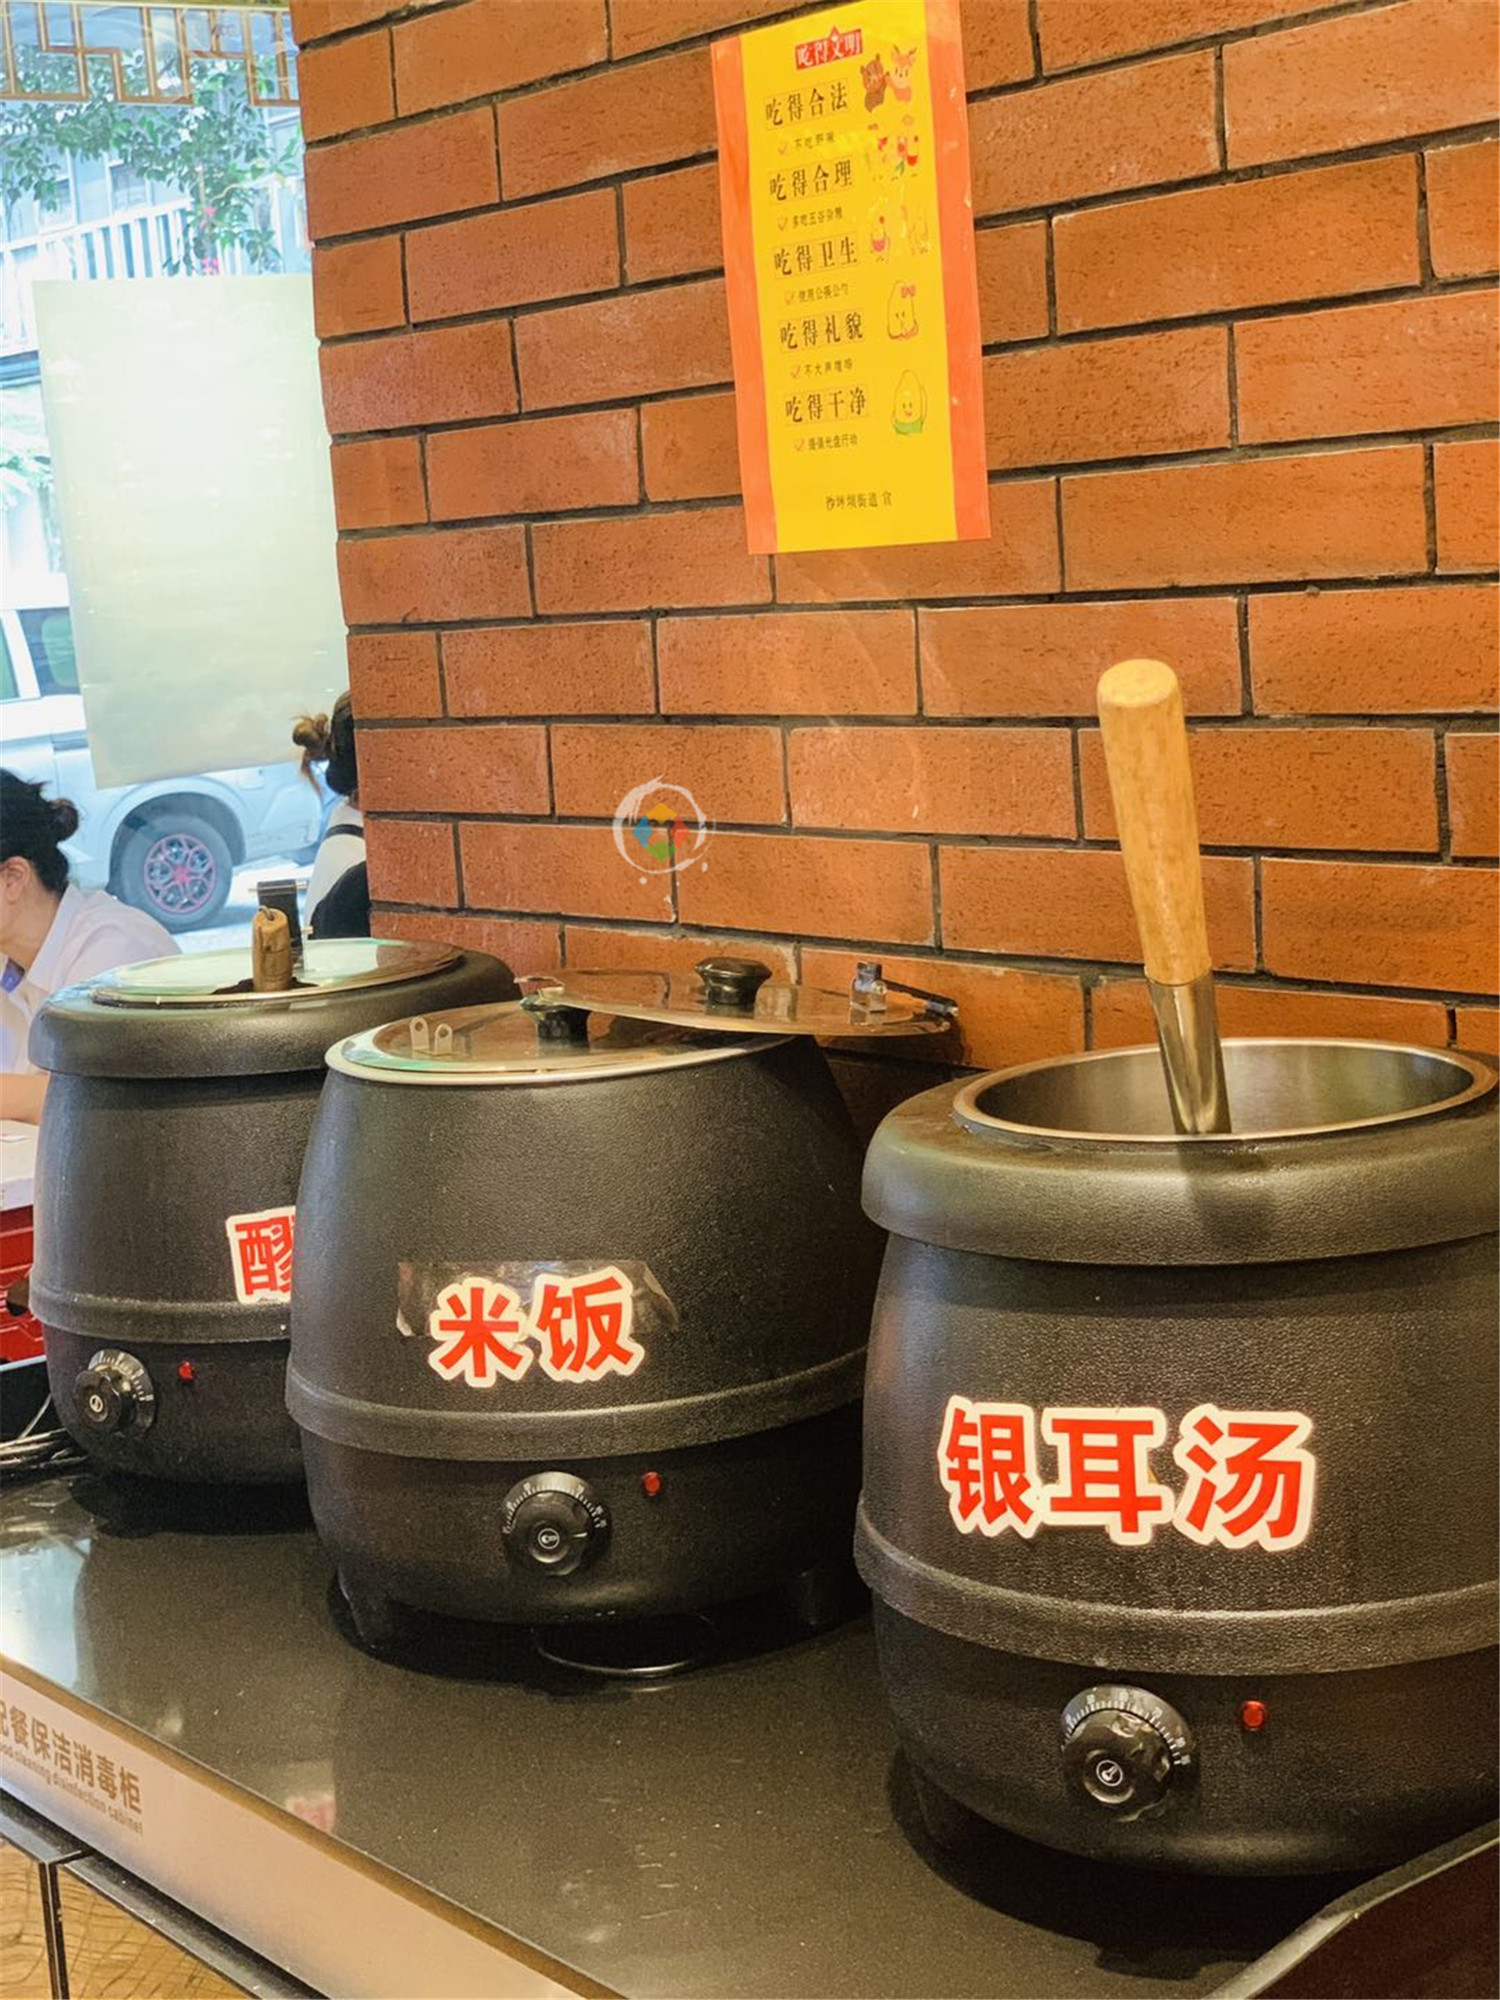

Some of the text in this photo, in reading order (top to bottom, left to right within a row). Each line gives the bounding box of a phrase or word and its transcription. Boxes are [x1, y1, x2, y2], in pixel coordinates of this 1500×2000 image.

[796, 31, 862, 68] 吃得文明
[765, 82, 848, 126] 吃得合法
[770, 160, 853, 200] 吃得合理
[774, 236, 858, 275] 吃得卫生
[780, 312, 863, 349] 吃得礼貌
[785, 387, 866, 423] 吃得干净
[436, 1273, 638, 1381] 米饭
[944, 1404, 1304, 1541] 银耳汤
